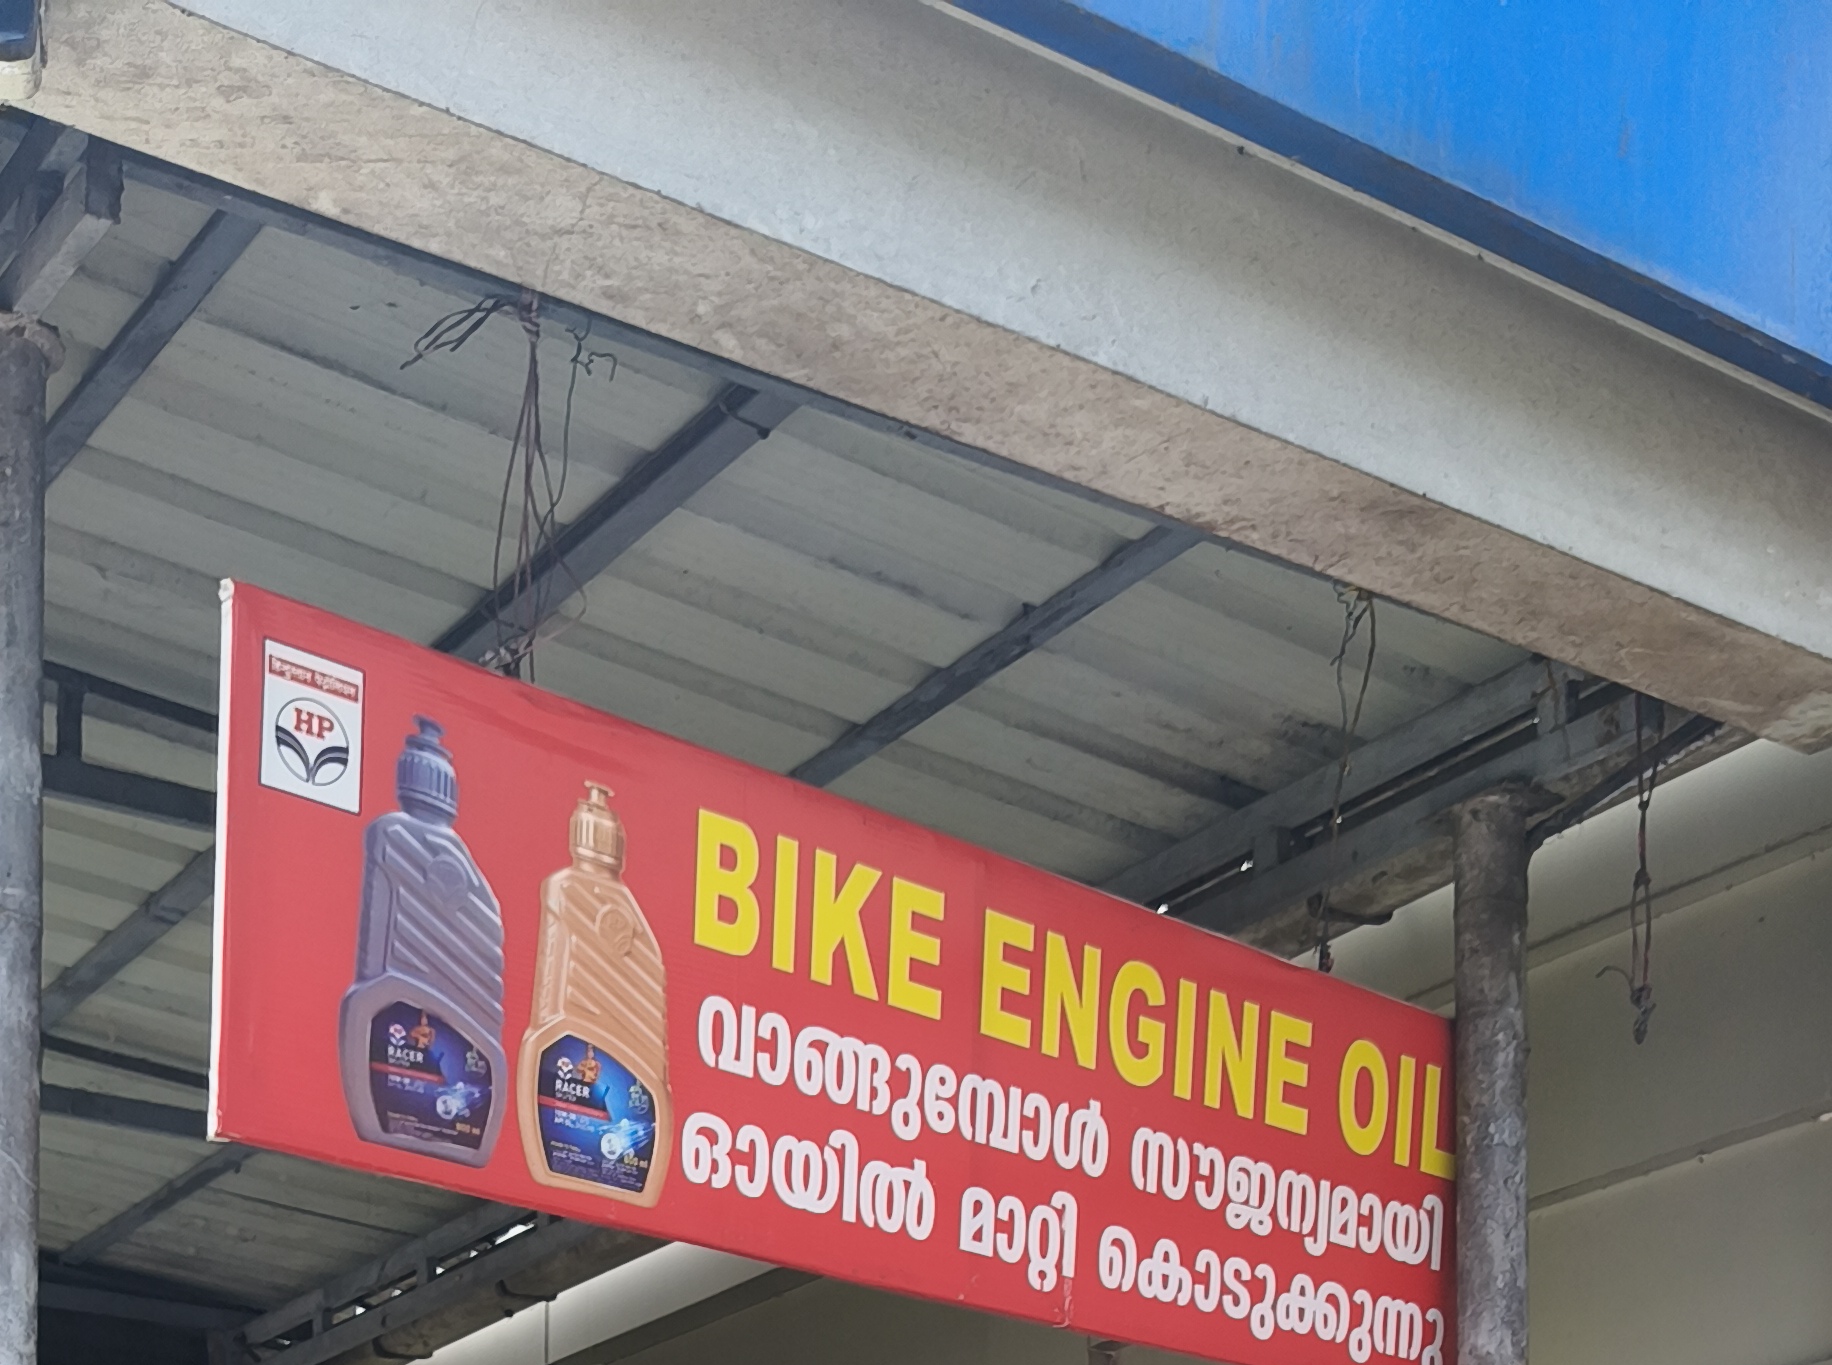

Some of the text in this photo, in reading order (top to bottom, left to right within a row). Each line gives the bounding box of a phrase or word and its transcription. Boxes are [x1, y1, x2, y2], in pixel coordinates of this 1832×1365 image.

[294, 706, 335, 740] HP
[694, 809, 1457, 1182] BIKE ENGINE OIL
[387, 1044, 424, 1064] RACER
[554, 1078, 590, 1099] RACER
[697, 994, 1445, 1272] വാങ്ങുമ്പോൾ സൗജന്യമായി
[681, 1111, 936, 1242] ഓയിൽ
[957, 1186, 1079, 1293] മാറ്റി
